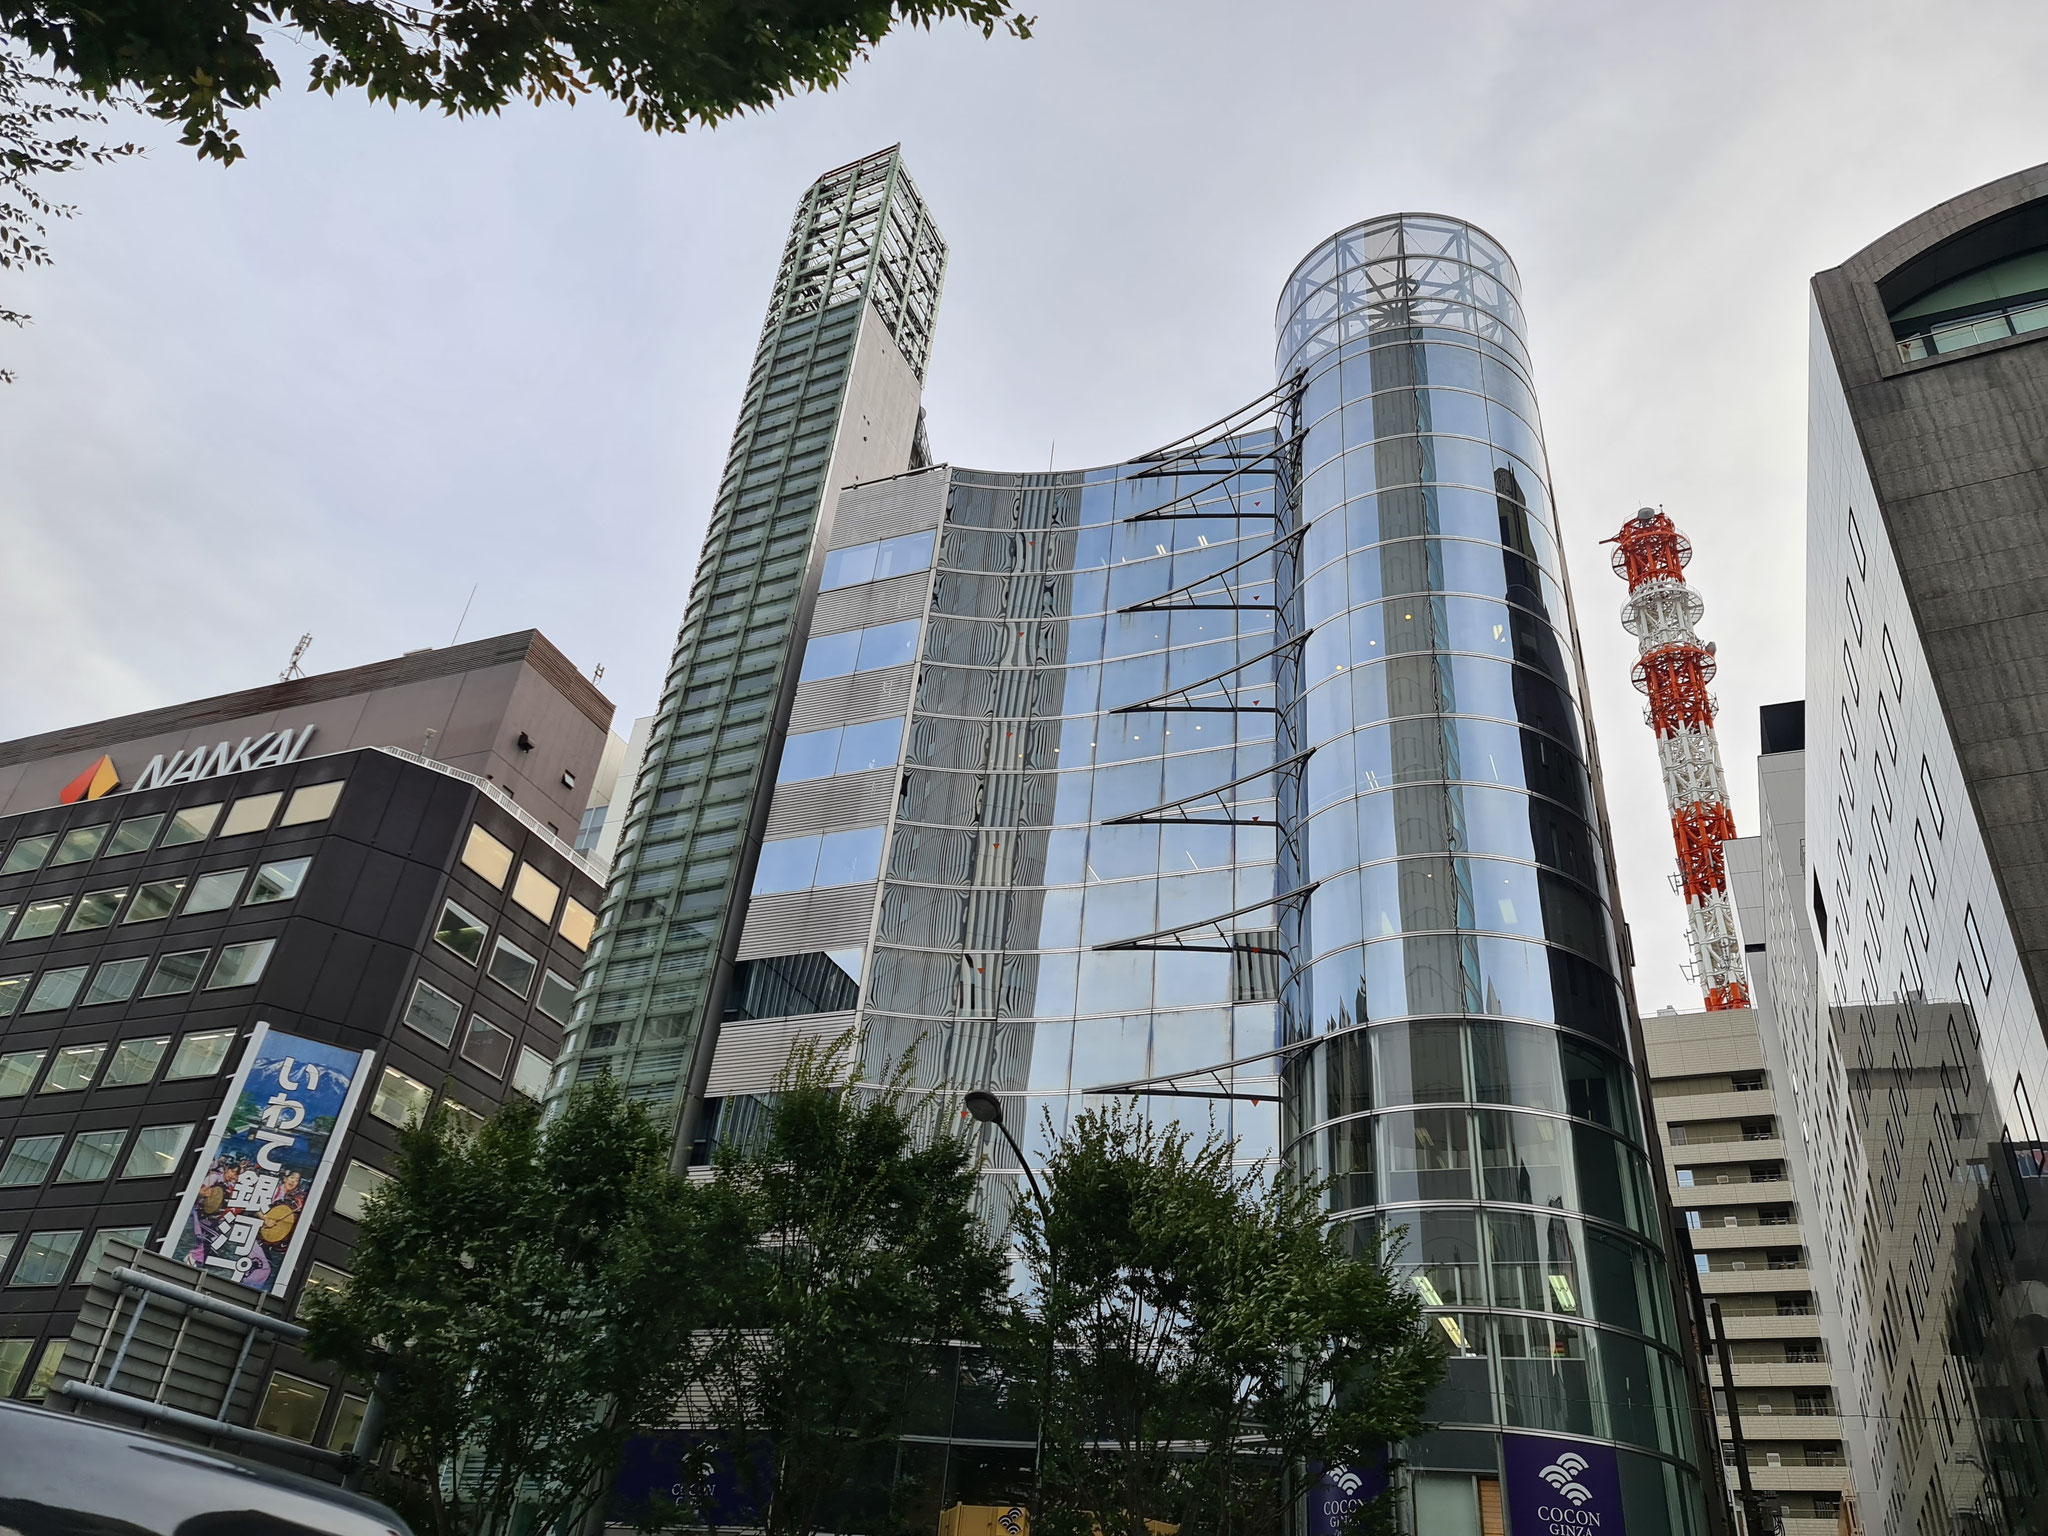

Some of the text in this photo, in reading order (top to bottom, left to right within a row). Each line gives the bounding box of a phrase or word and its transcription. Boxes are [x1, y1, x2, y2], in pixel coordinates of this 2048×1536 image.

[132, 724, 316, 792] NANKAI
[1537, 1506, 1601, 1527] COCON
[1549, 1523, 1593, 1536] GINZA
